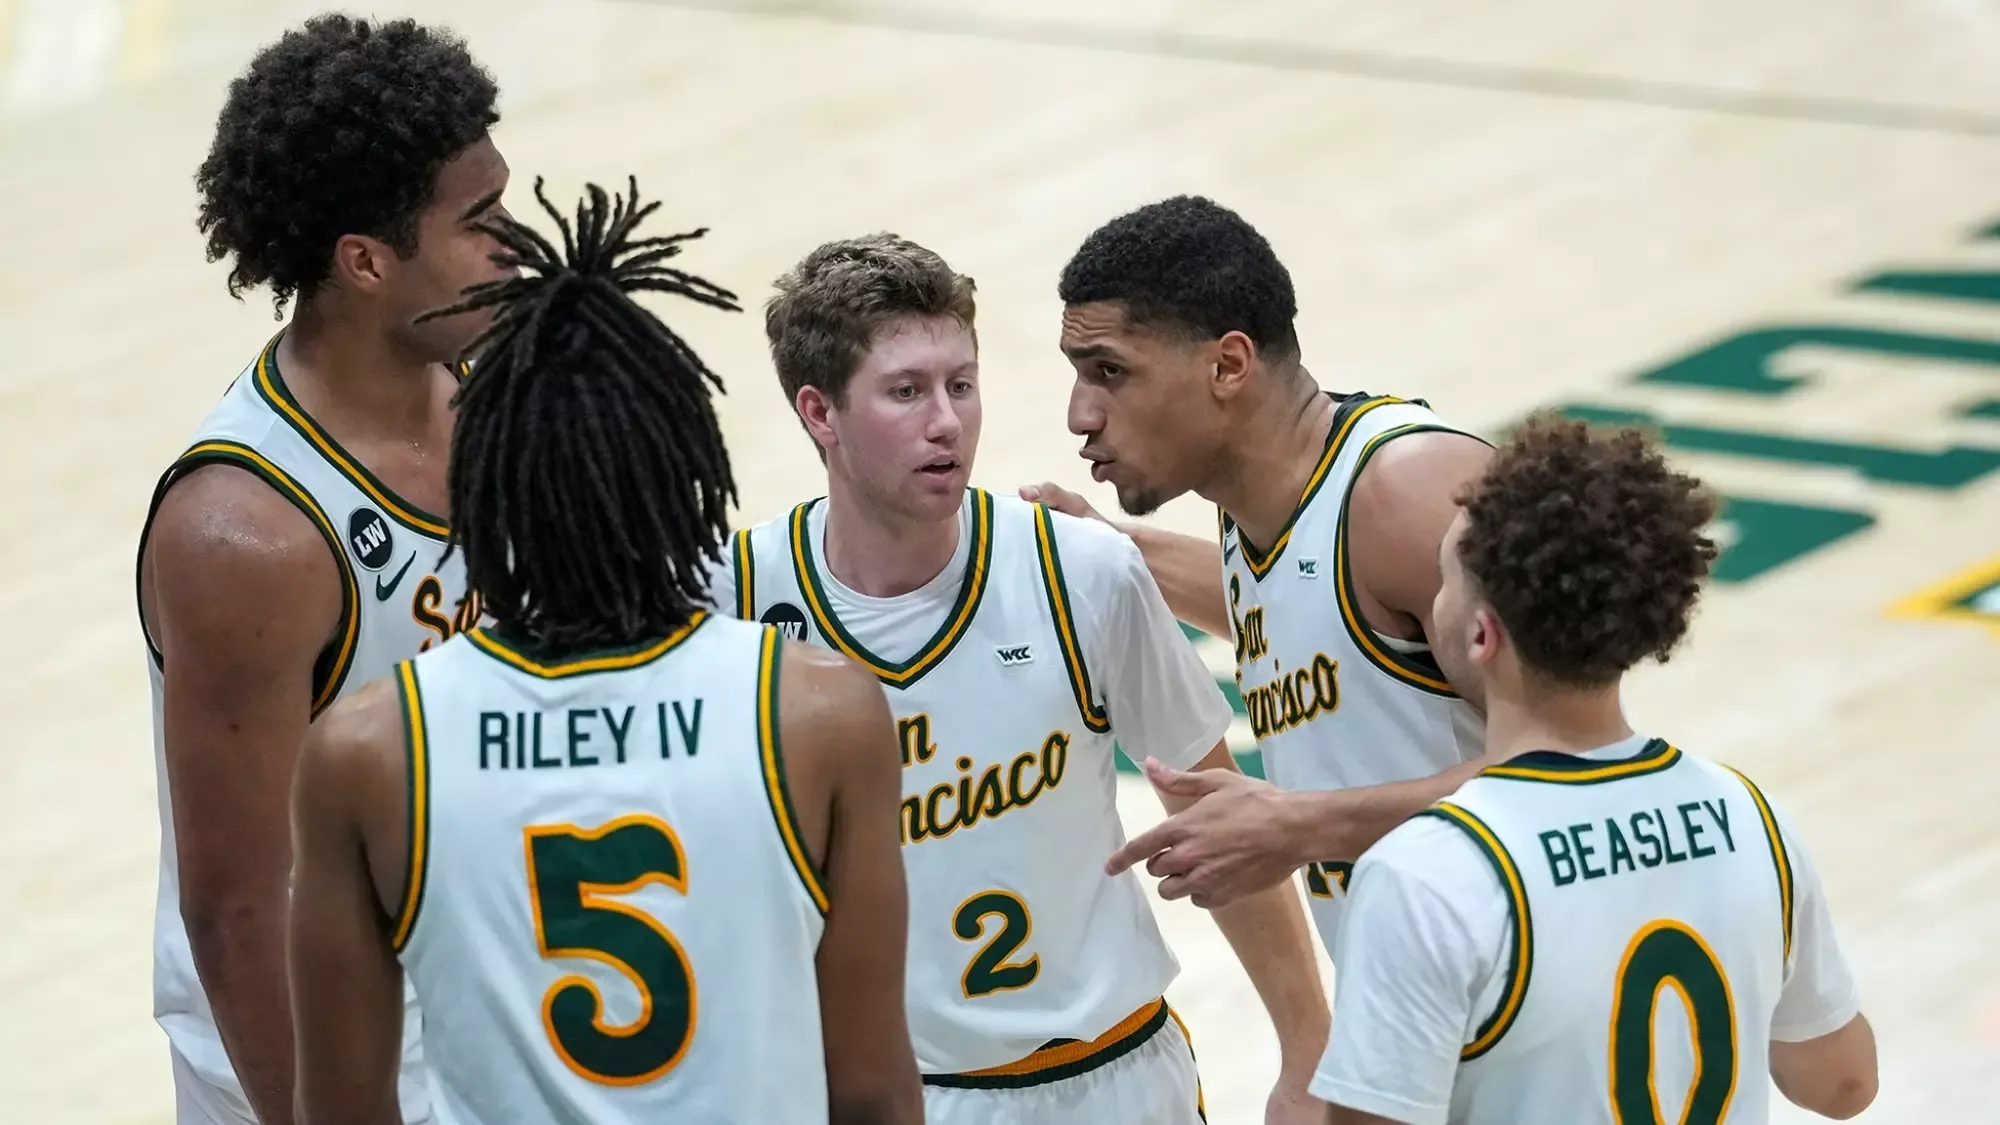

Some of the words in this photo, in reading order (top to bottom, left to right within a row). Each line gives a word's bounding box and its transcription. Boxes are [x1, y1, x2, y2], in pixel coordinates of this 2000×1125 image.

[354, 518, 387, 558] LW
[480, 705, 635, 770] RILEY
[658, 699, 703, 759] IV
[900, 730, 1070, 846] ncisco
[1538, 798, 1736, 887] BEASLEY
[522, 812, 697, 1088] 5
[952, 888, 1041, 999] 2
[1608, 918, 1739, 1125] 0
